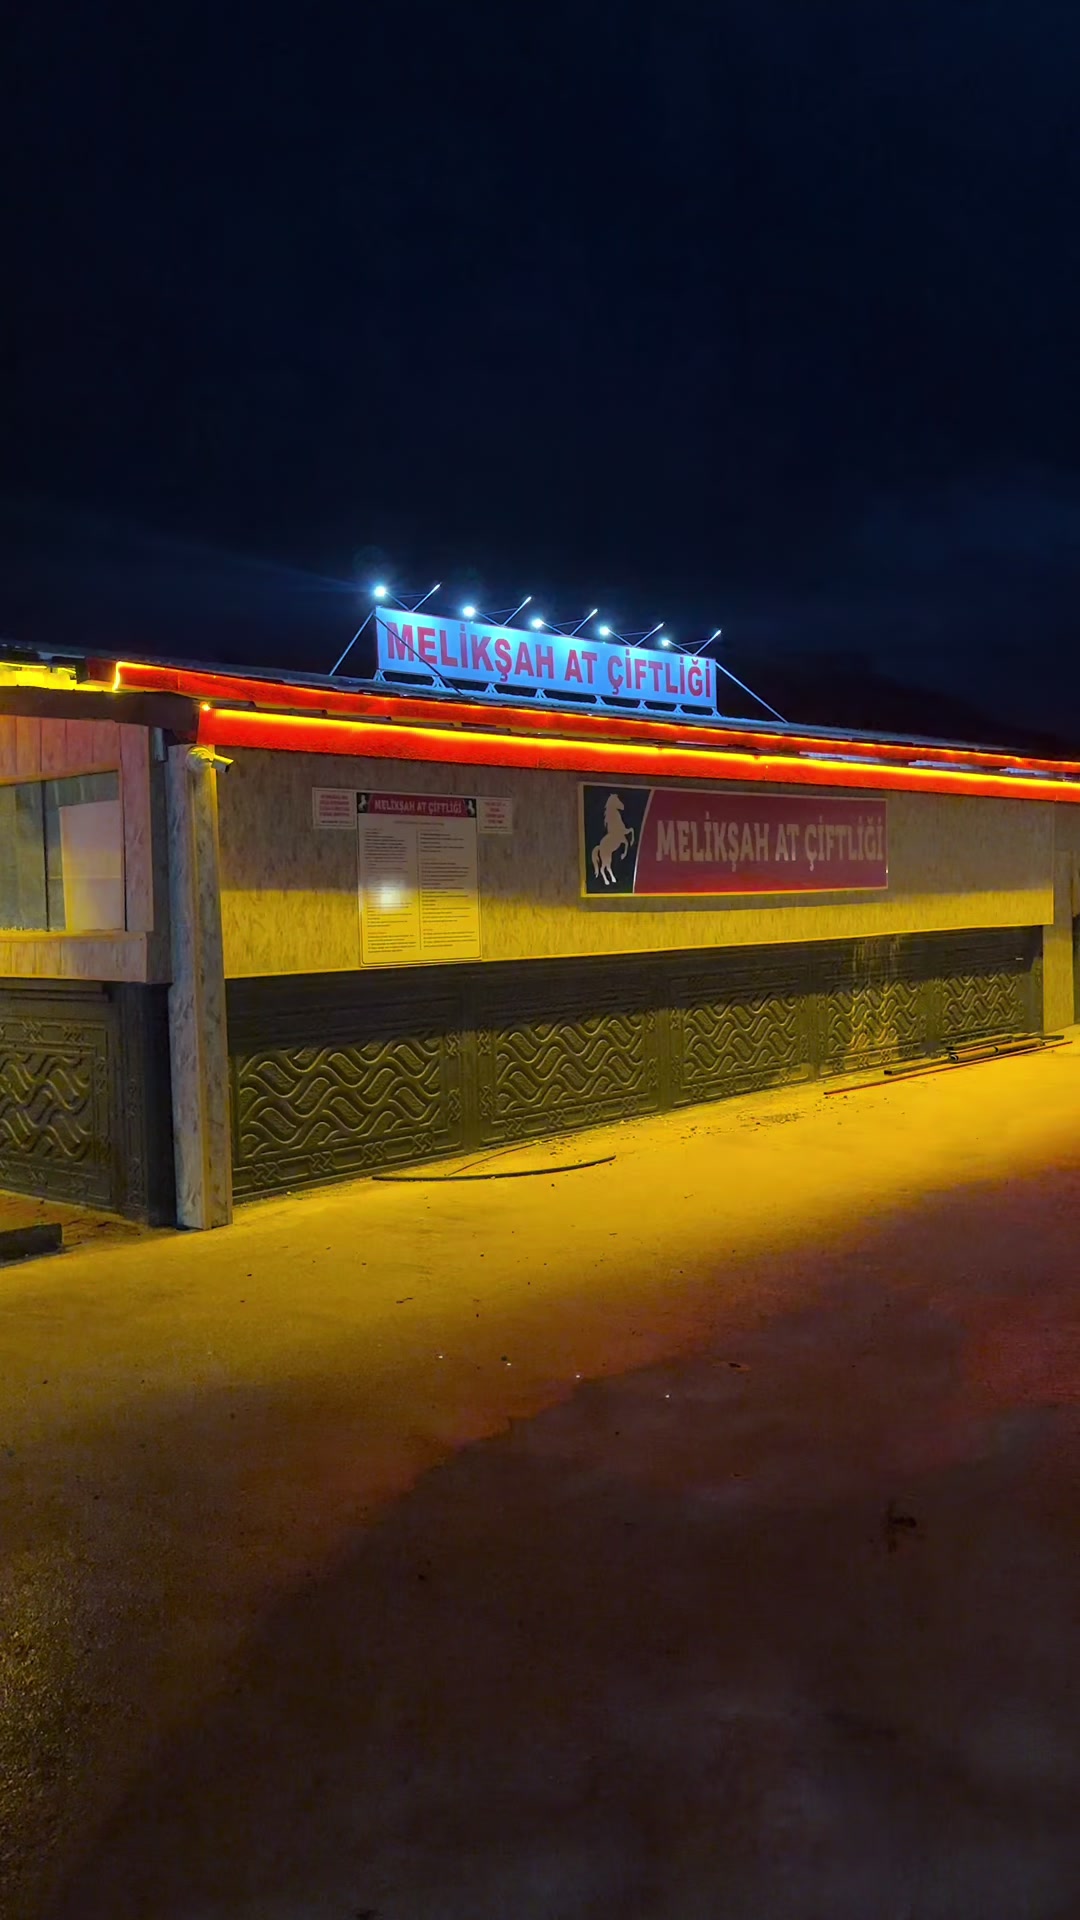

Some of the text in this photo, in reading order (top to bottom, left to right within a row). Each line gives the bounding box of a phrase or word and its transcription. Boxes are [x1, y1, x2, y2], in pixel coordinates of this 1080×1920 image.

[387, 622, 711, 698] MELİKŞAH AT ÇİFTLİĞİ
[655, 811, 883, 872] MELİKŞAH AT ÇİFTLİĞİ
